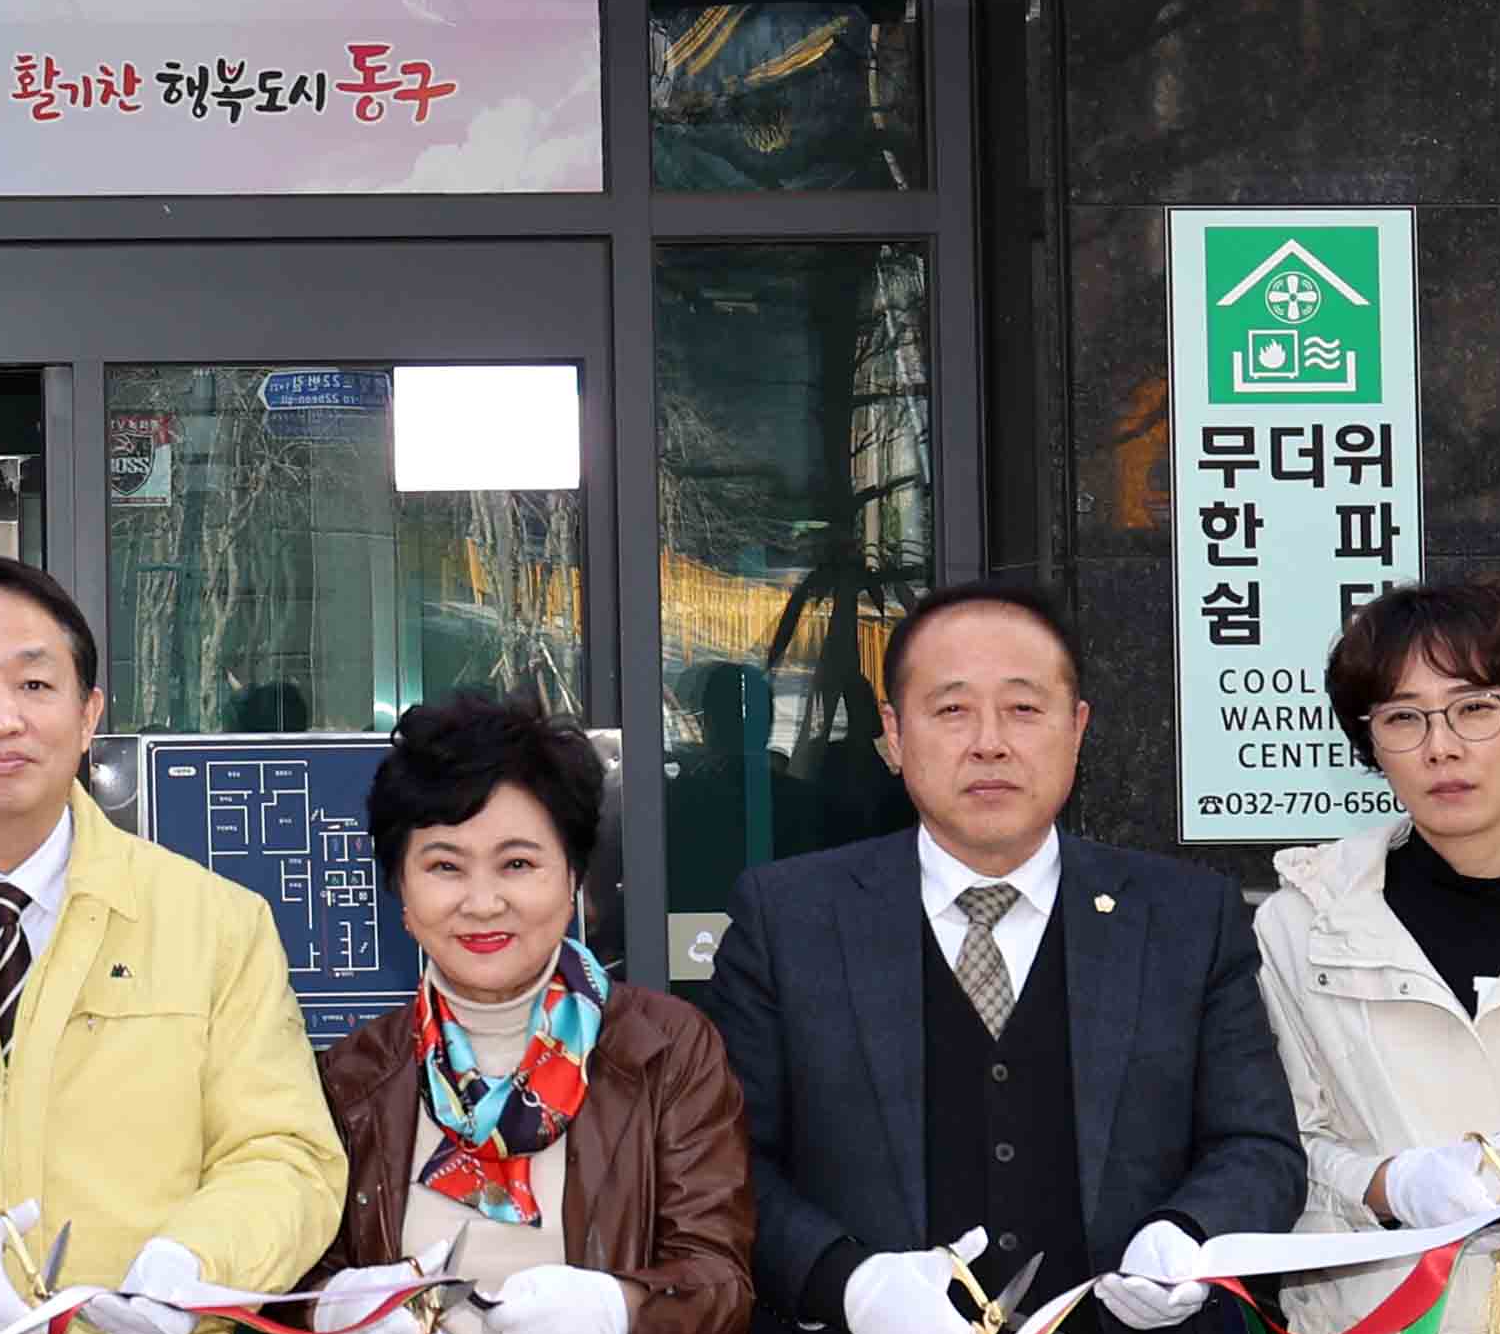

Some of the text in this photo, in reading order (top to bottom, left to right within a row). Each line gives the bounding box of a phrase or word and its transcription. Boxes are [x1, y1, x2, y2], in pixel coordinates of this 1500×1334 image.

[13, 56, 141, 120] 활기찬
[156, 59, 325, 123] 행복도시
[336, 45, 455, 121] 동구
[1199, 424, 1392, 488] 무더위
